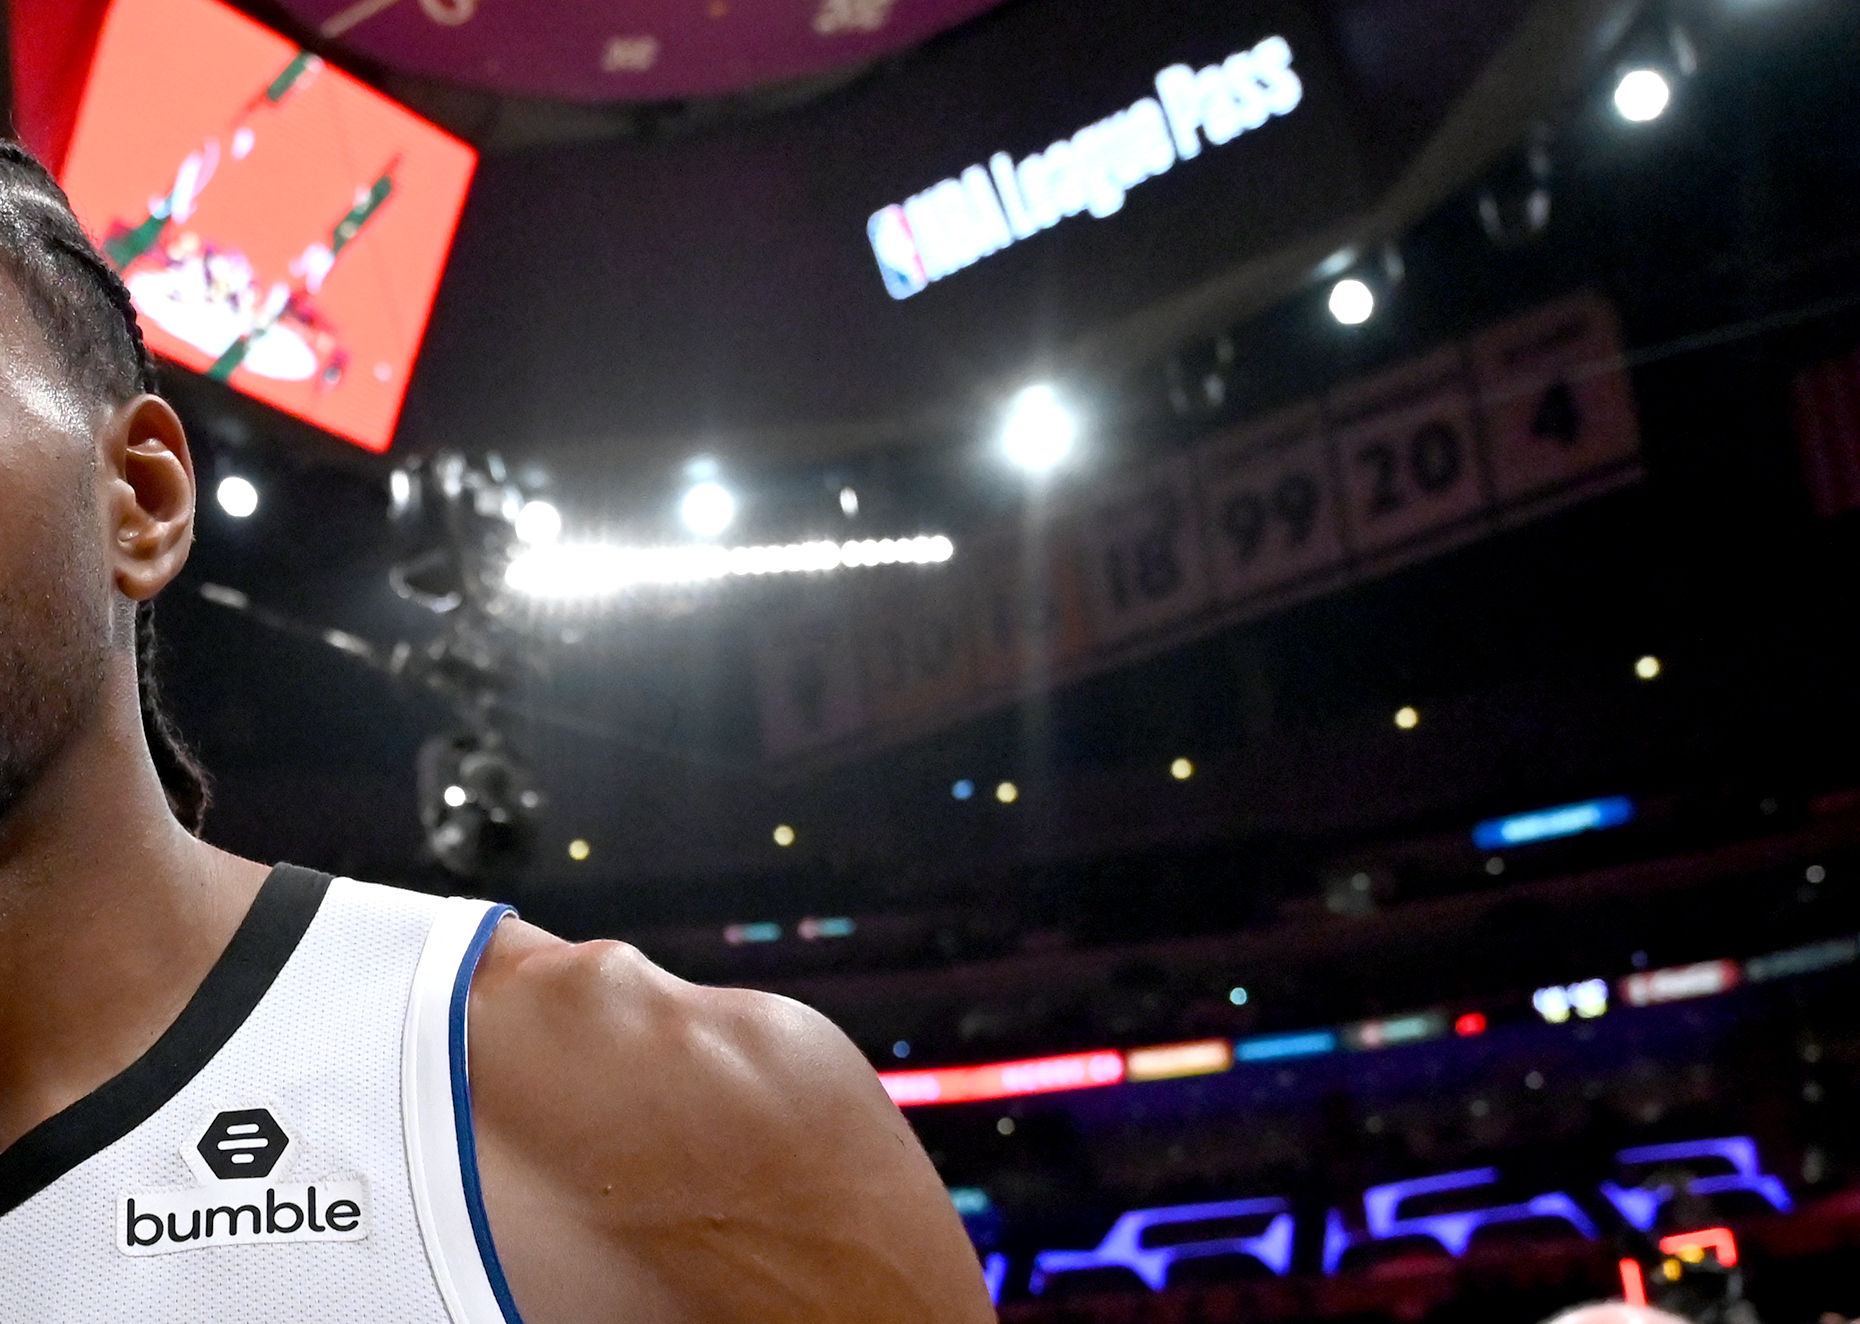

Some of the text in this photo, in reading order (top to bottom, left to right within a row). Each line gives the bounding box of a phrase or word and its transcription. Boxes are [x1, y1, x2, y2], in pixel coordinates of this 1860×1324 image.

[989, 97, 1177, 240] League
[1154, 34, 1303, 161] Pass
[126, 1186, 362, 1247] bumble
